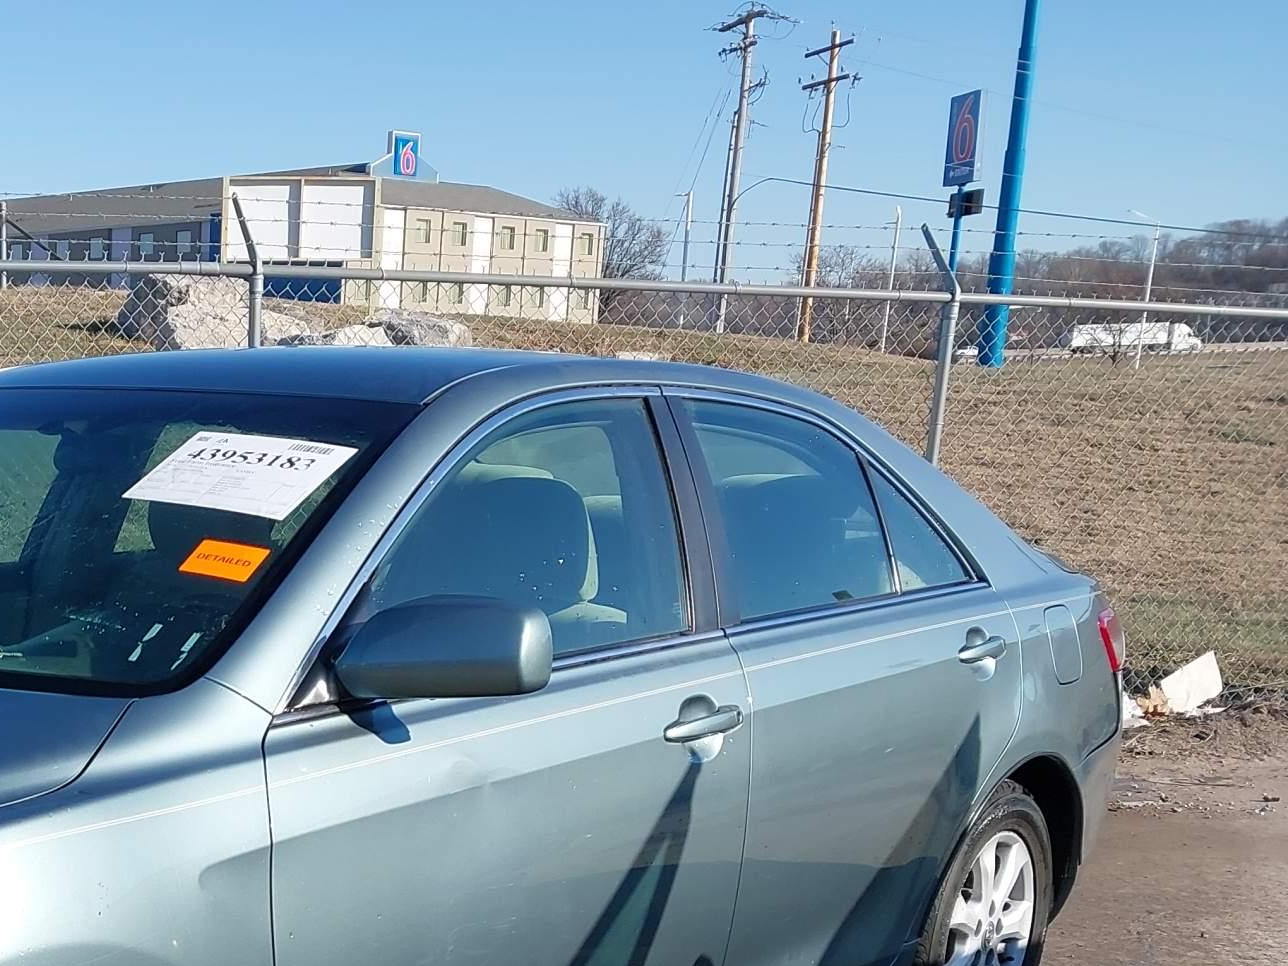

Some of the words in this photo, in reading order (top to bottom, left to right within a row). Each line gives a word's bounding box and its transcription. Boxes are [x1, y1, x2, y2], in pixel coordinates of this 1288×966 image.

[953, 94, 974, 162] 6
[400, 141, 416, 176] 6
[187, 447, 316, 470] 43953183
[196, 552, 252, 567] DETAILED
